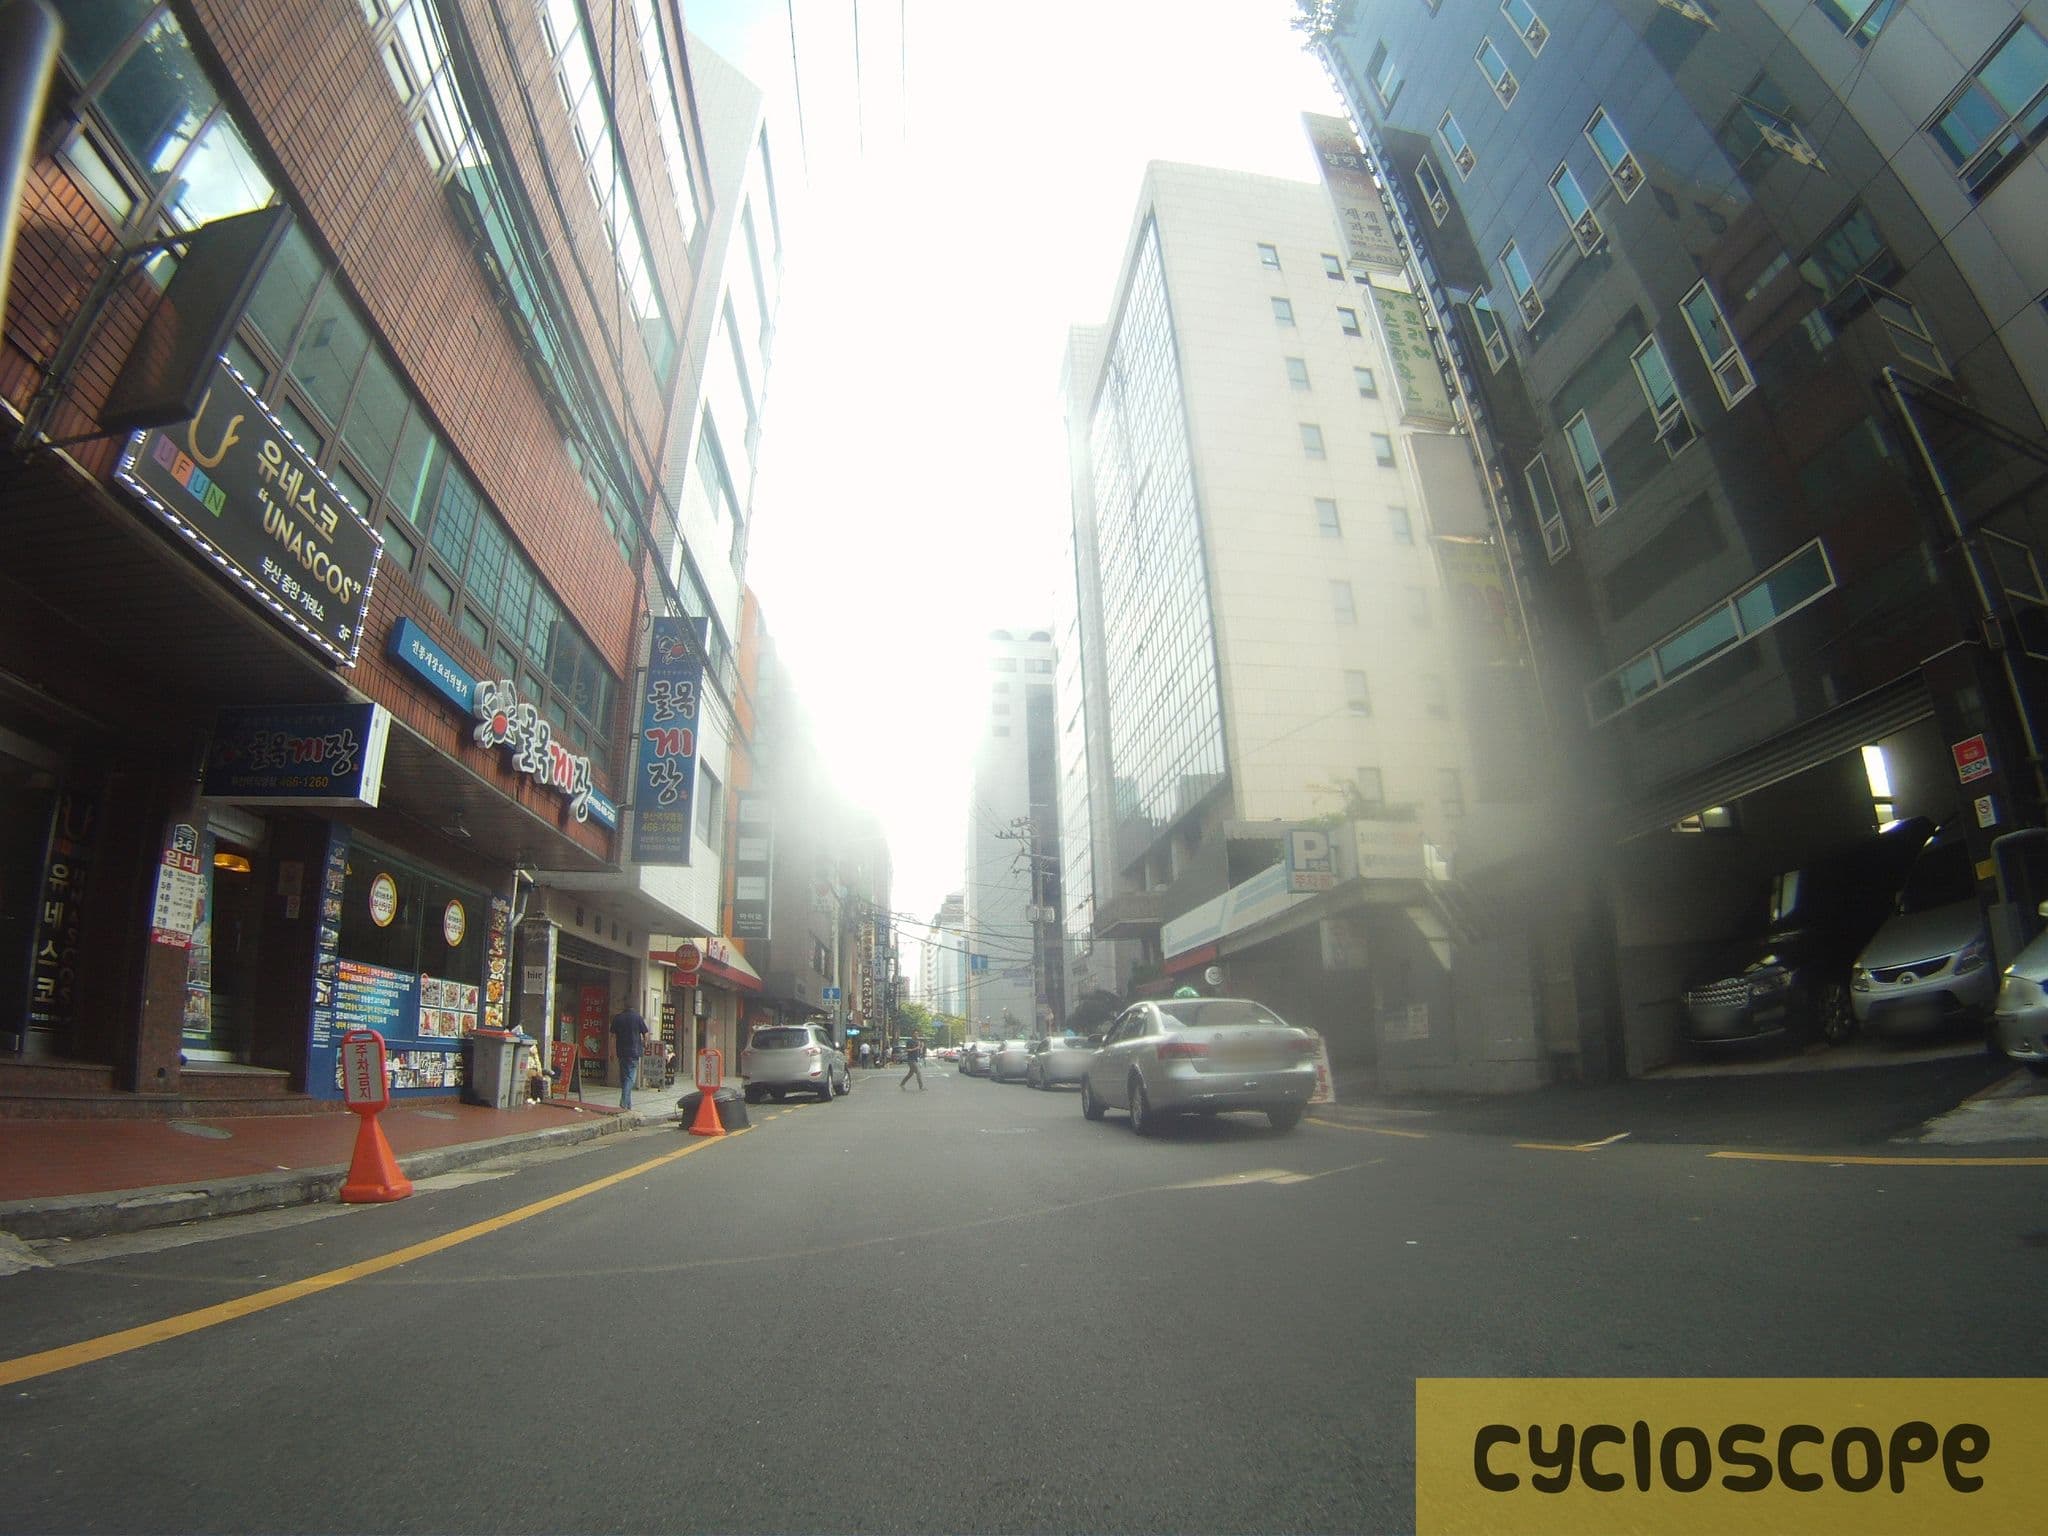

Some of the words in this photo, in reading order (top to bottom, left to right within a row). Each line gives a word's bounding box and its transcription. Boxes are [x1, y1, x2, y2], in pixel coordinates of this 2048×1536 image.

[257, 438, 339, 545] 유네스코
[261, 555, 283, 585] 부산
[281, 573, 301, 601] 중앙
[337, 623, 352, 642] 3F
[247, 727, 359, 778] 골목게장
[517, 702, 594, 824] 골목게장
[166, 849, 201, 875] 임대
[32, 862, 70, 1005] 유네스코
[355, 1040, 372, 1101] 주차금지
